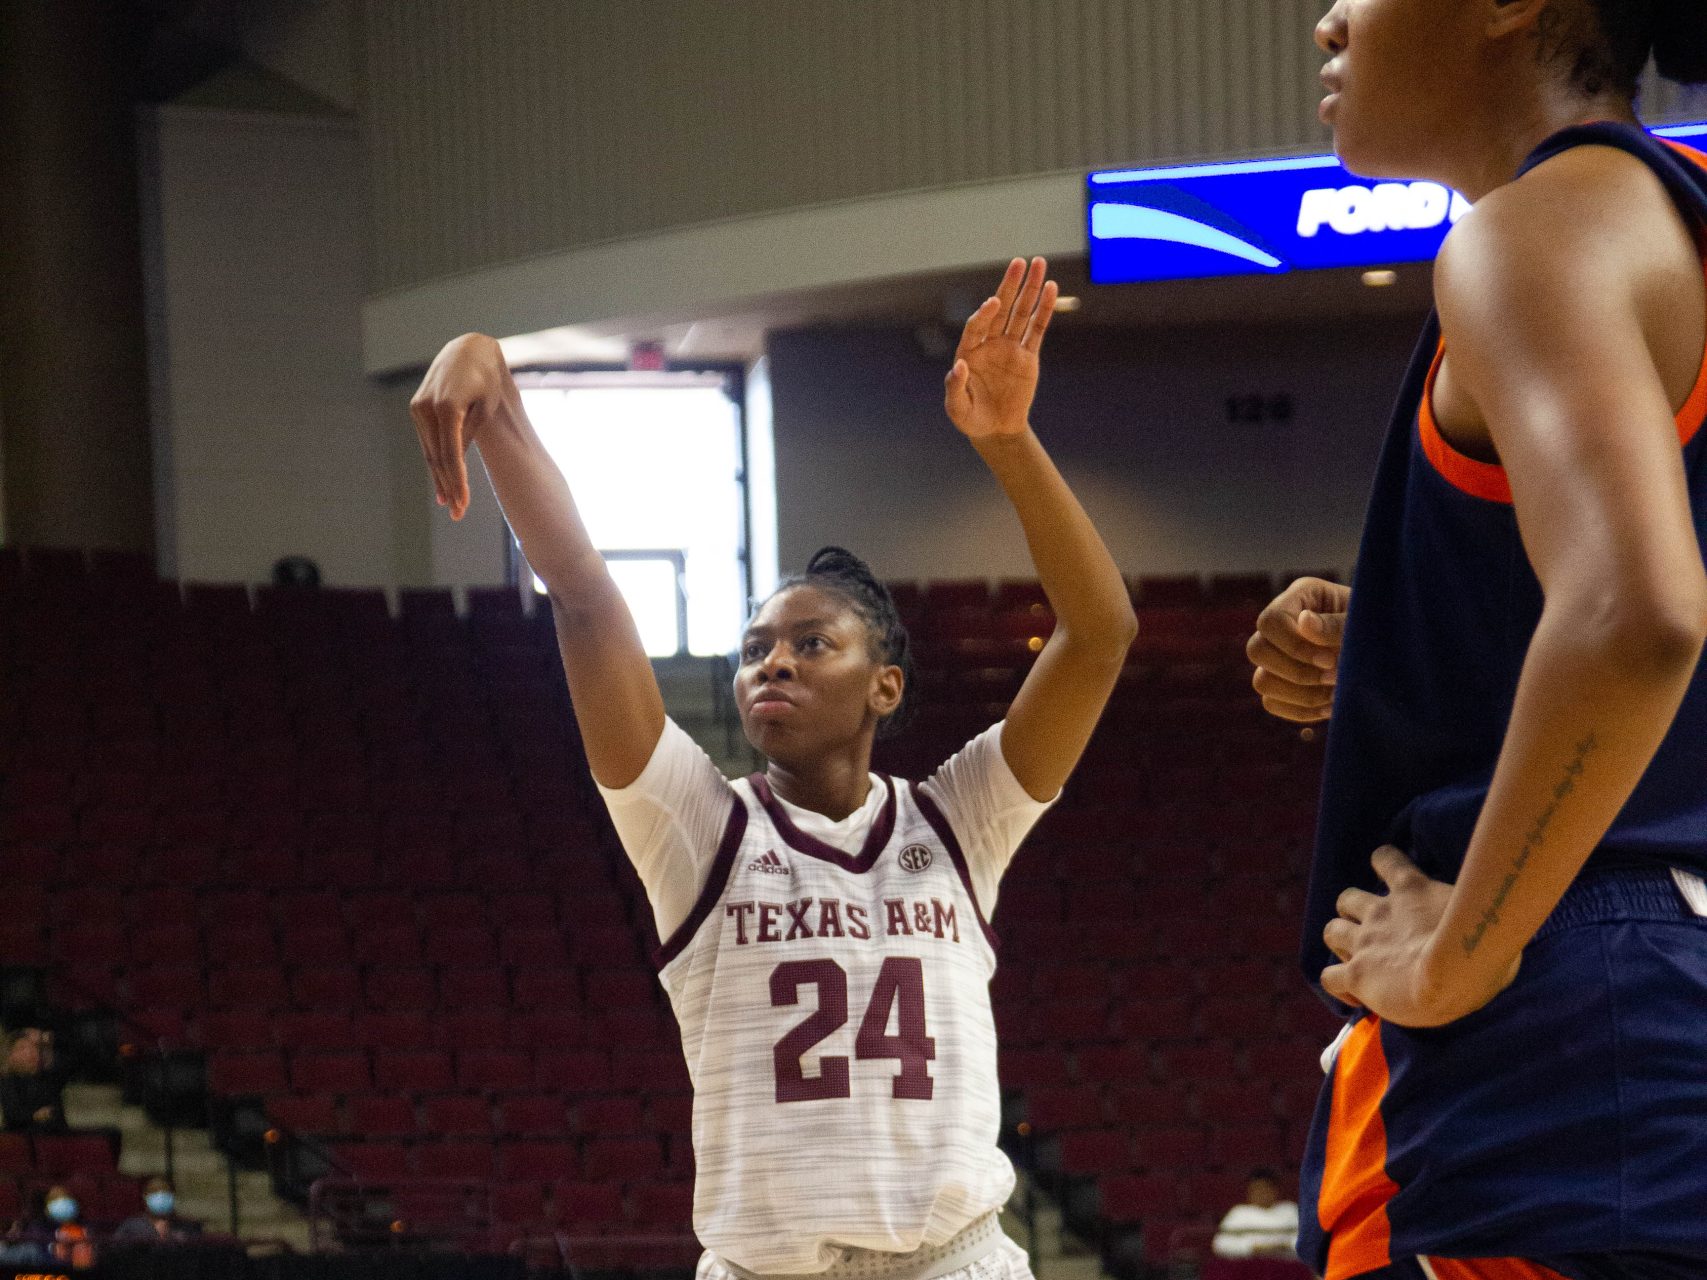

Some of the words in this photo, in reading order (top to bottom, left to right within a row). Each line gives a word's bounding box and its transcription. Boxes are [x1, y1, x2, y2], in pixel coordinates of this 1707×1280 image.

[748, 864, 789, 875] adidas
[726, 897, 872, 945] TEXAS
[884, 897, 960, 943] A&M
[769, 956, 936, 1103] 24
